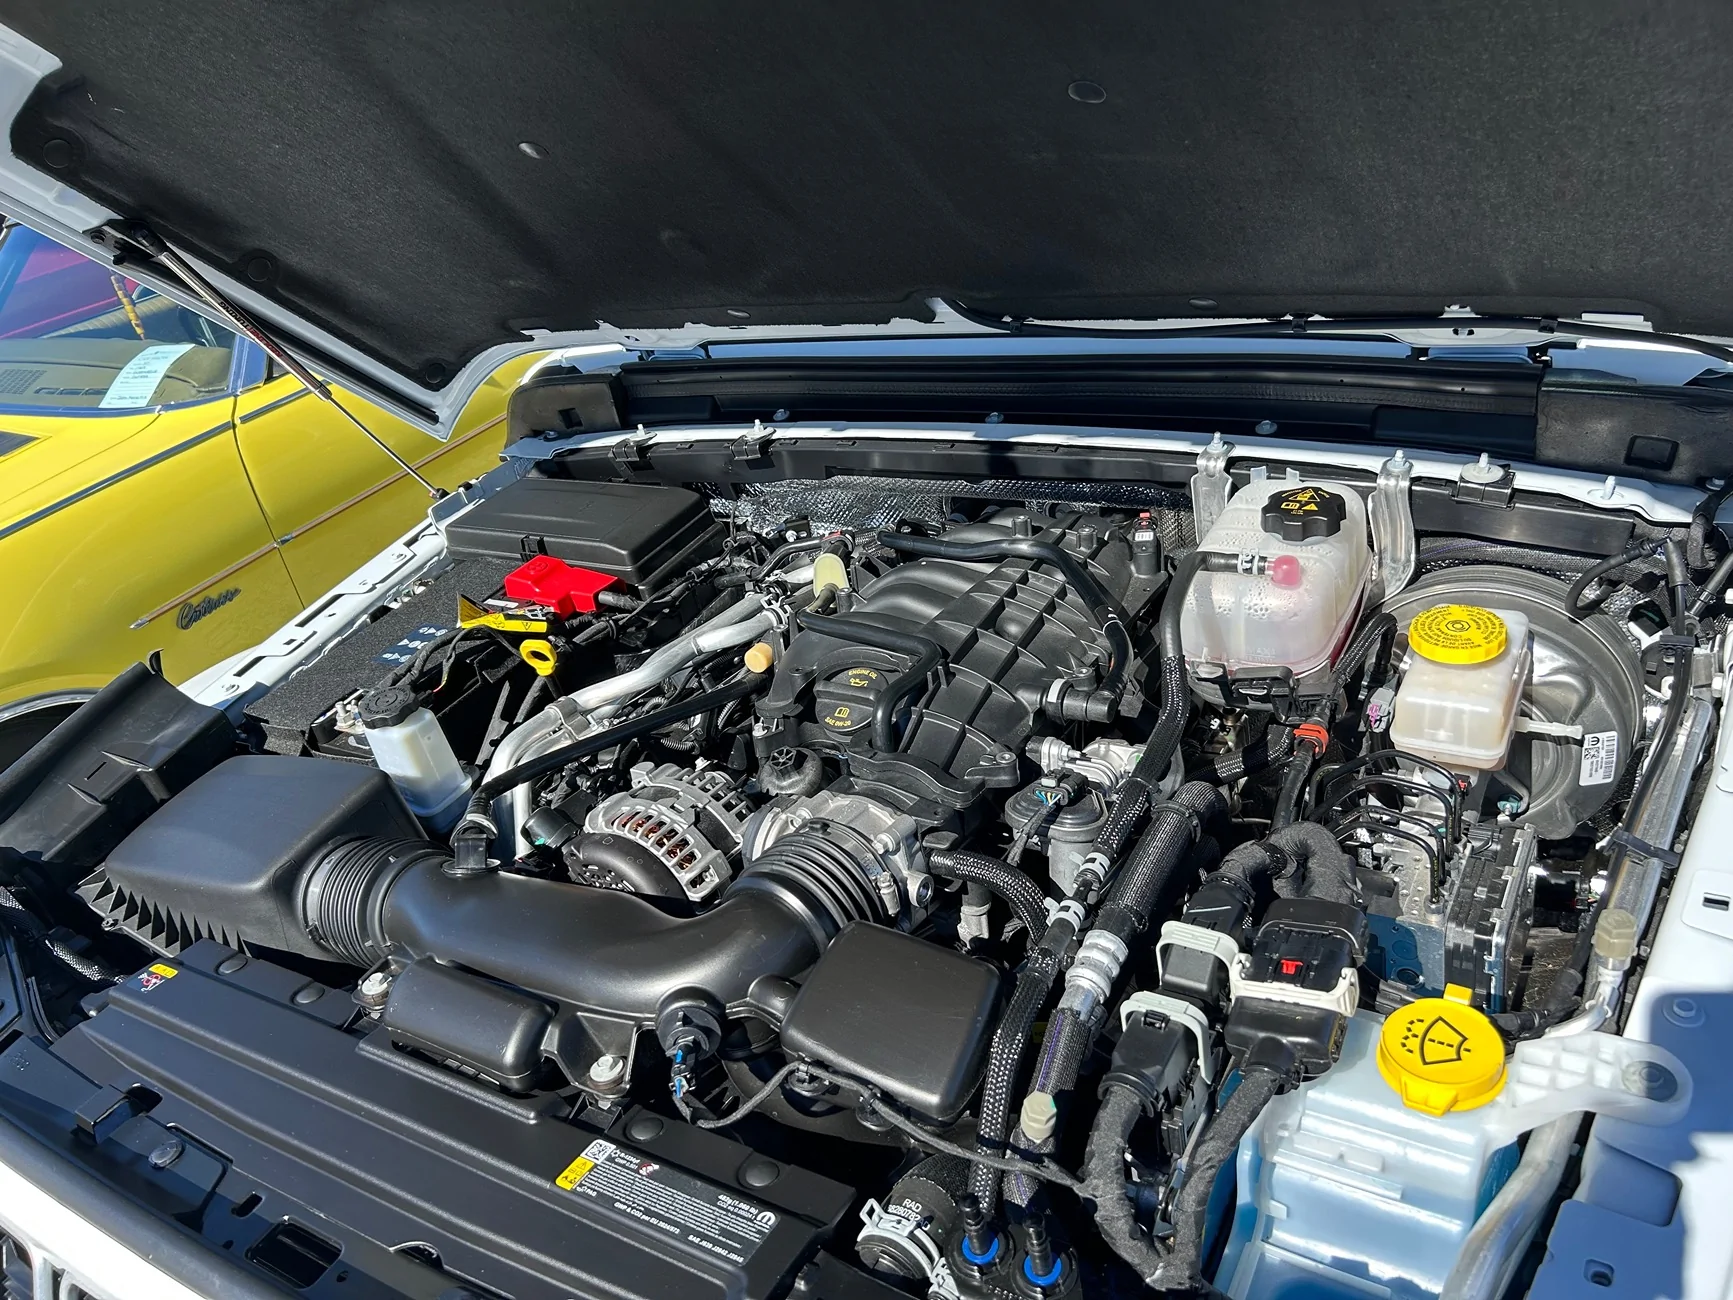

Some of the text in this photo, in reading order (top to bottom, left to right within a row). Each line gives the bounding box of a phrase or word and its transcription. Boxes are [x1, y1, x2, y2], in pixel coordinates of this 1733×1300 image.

[219, 301, 250, 329] TUNING
[868, 671, 878, 680] OIL
[824, 716, 836, 726] SAE
[902, 1198, 922, 1212] RAD
[614, 1201, 628, 1210] GWP
[630, 1209, 643, 1217] CO2
[649, 1217, 660, 1225] EU
[687, 1234, 702, 1246] SAE
